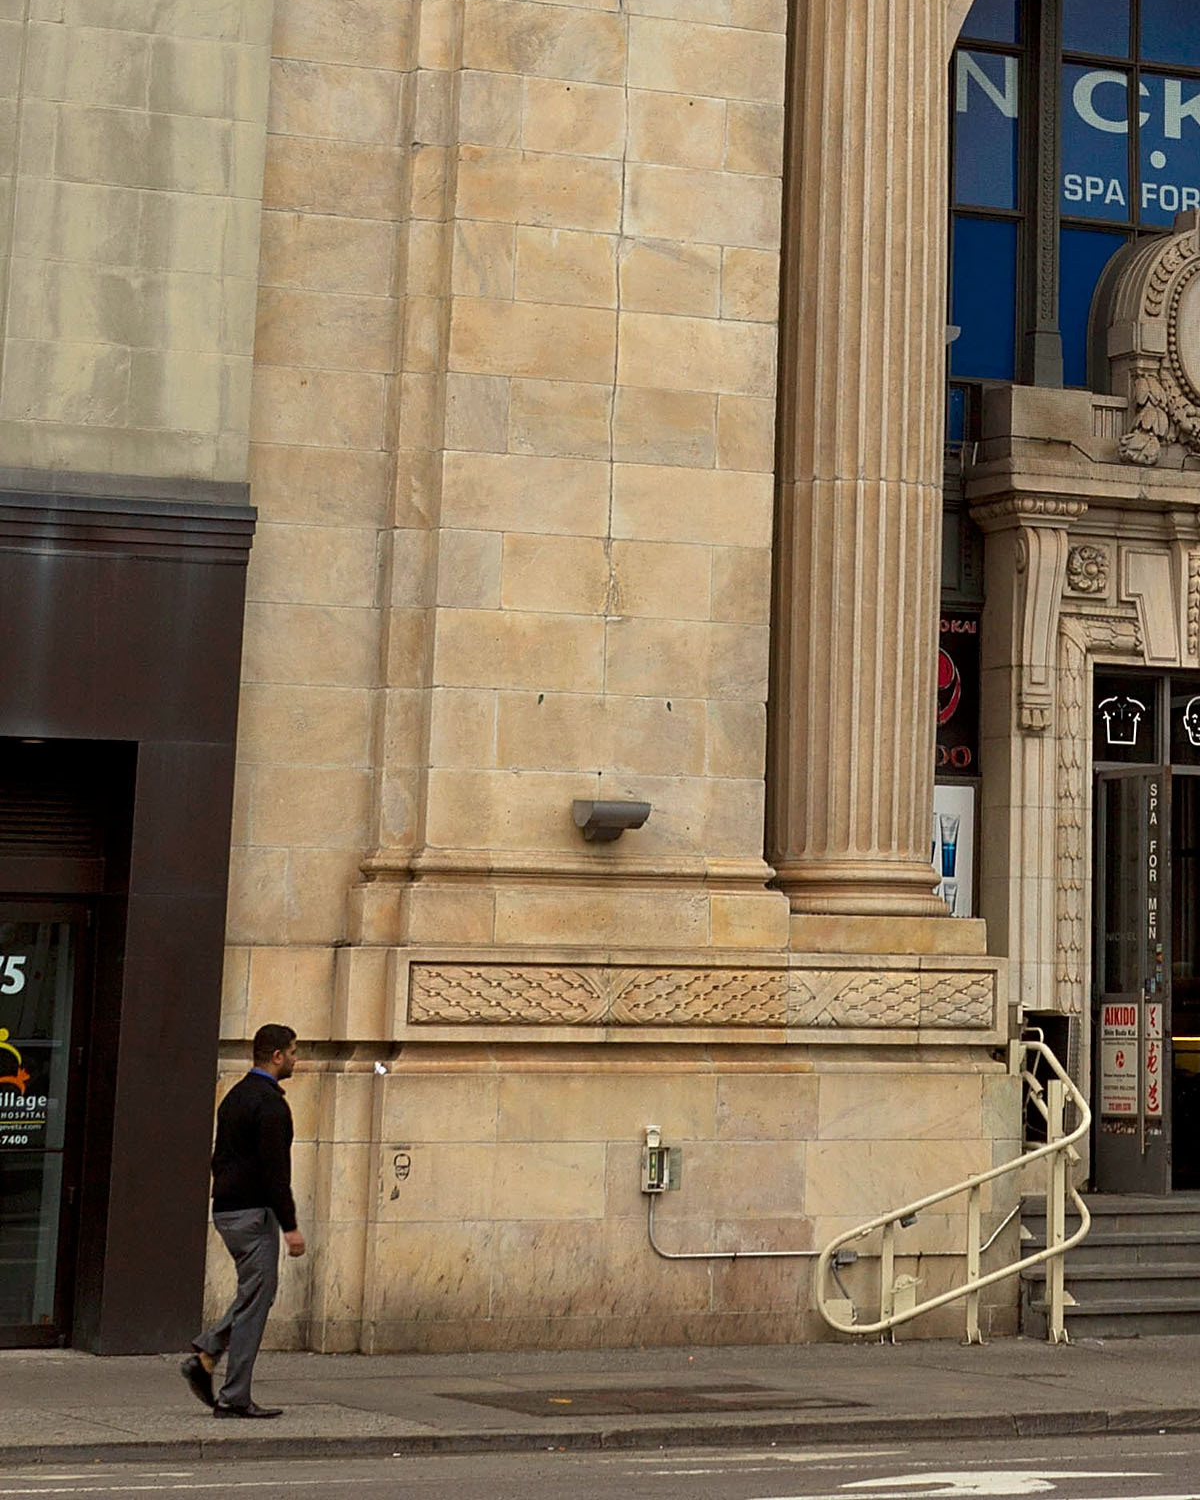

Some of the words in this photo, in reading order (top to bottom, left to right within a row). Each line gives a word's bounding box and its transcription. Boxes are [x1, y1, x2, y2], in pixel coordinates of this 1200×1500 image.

[1064, 174, 1125, 206] SPA
[1142, 183, 1200, 213] FOR
[1150, 784, 1158, 825] SPA
[1149, 841, 1157, 882] FOR
[1148, 898, 1157, 939] MEN
[0, 956, 26, 994] 5
[1104, 1007, 1136, 1026] AIKIDO
